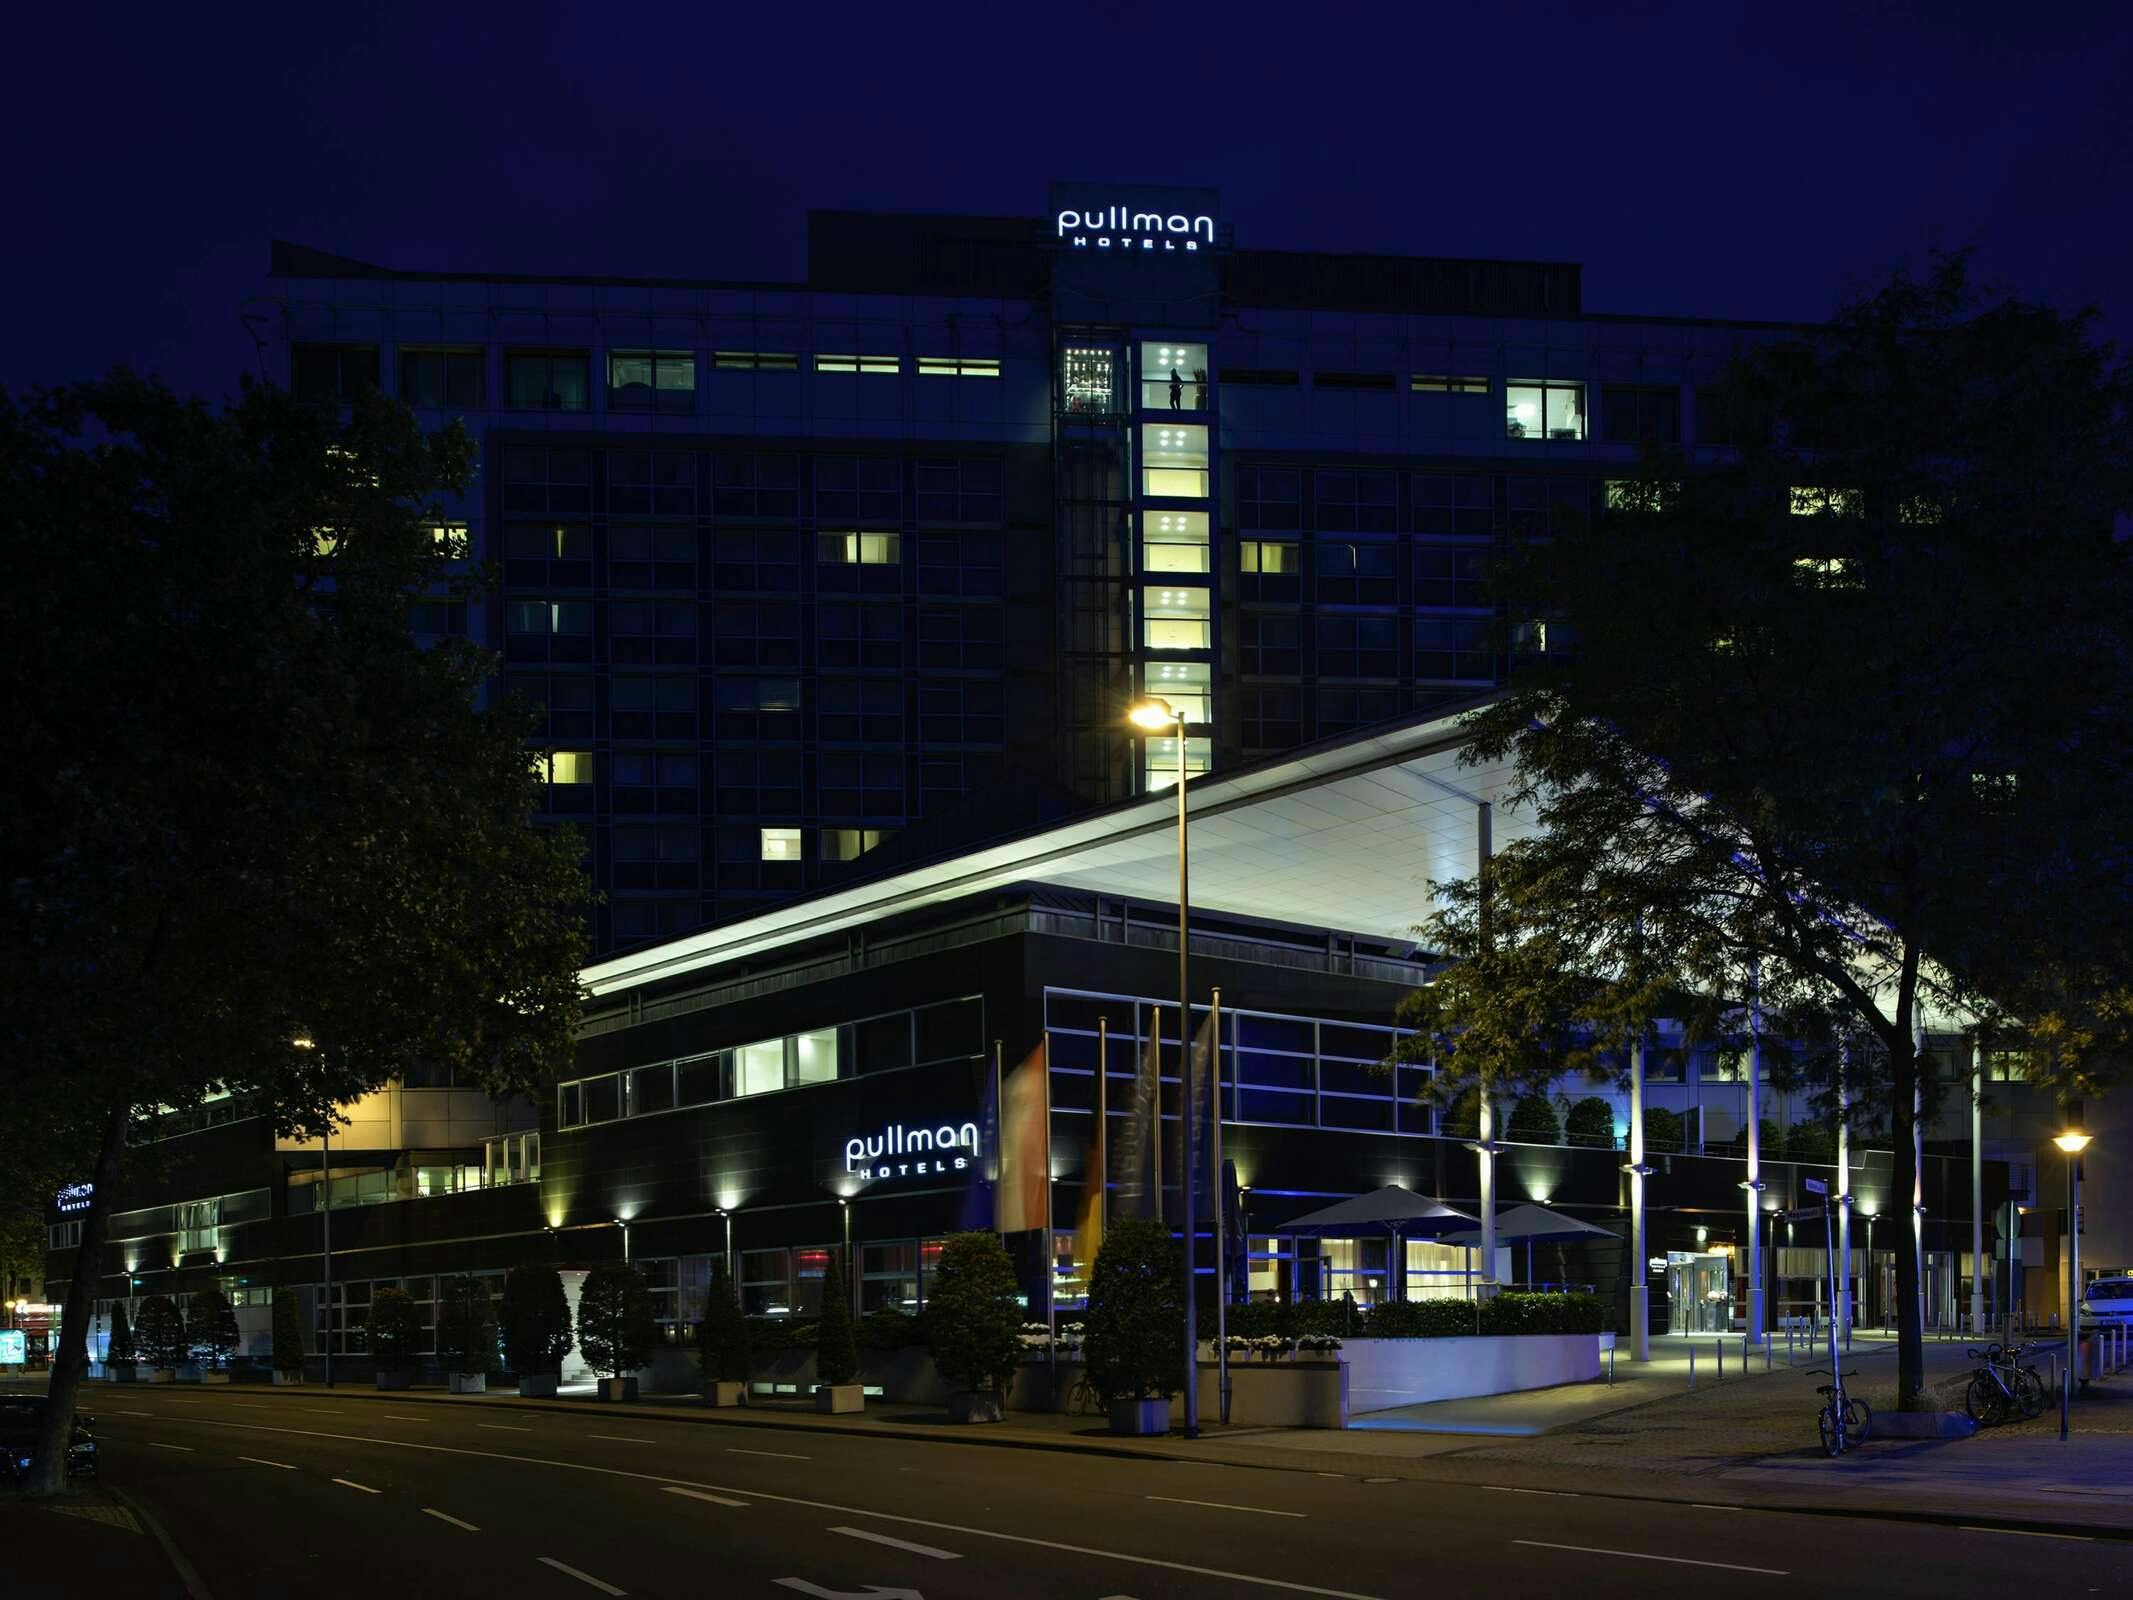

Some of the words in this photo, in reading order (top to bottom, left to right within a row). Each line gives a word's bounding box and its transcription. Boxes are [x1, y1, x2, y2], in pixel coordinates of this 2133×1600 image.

[1058, 206, 1213, 242] pullman
[1073, 236, 1198, 251] HOTELS
[846, 1122, 978, 1172] pullman
[860, 1157, 968, 1180] HOTELS
